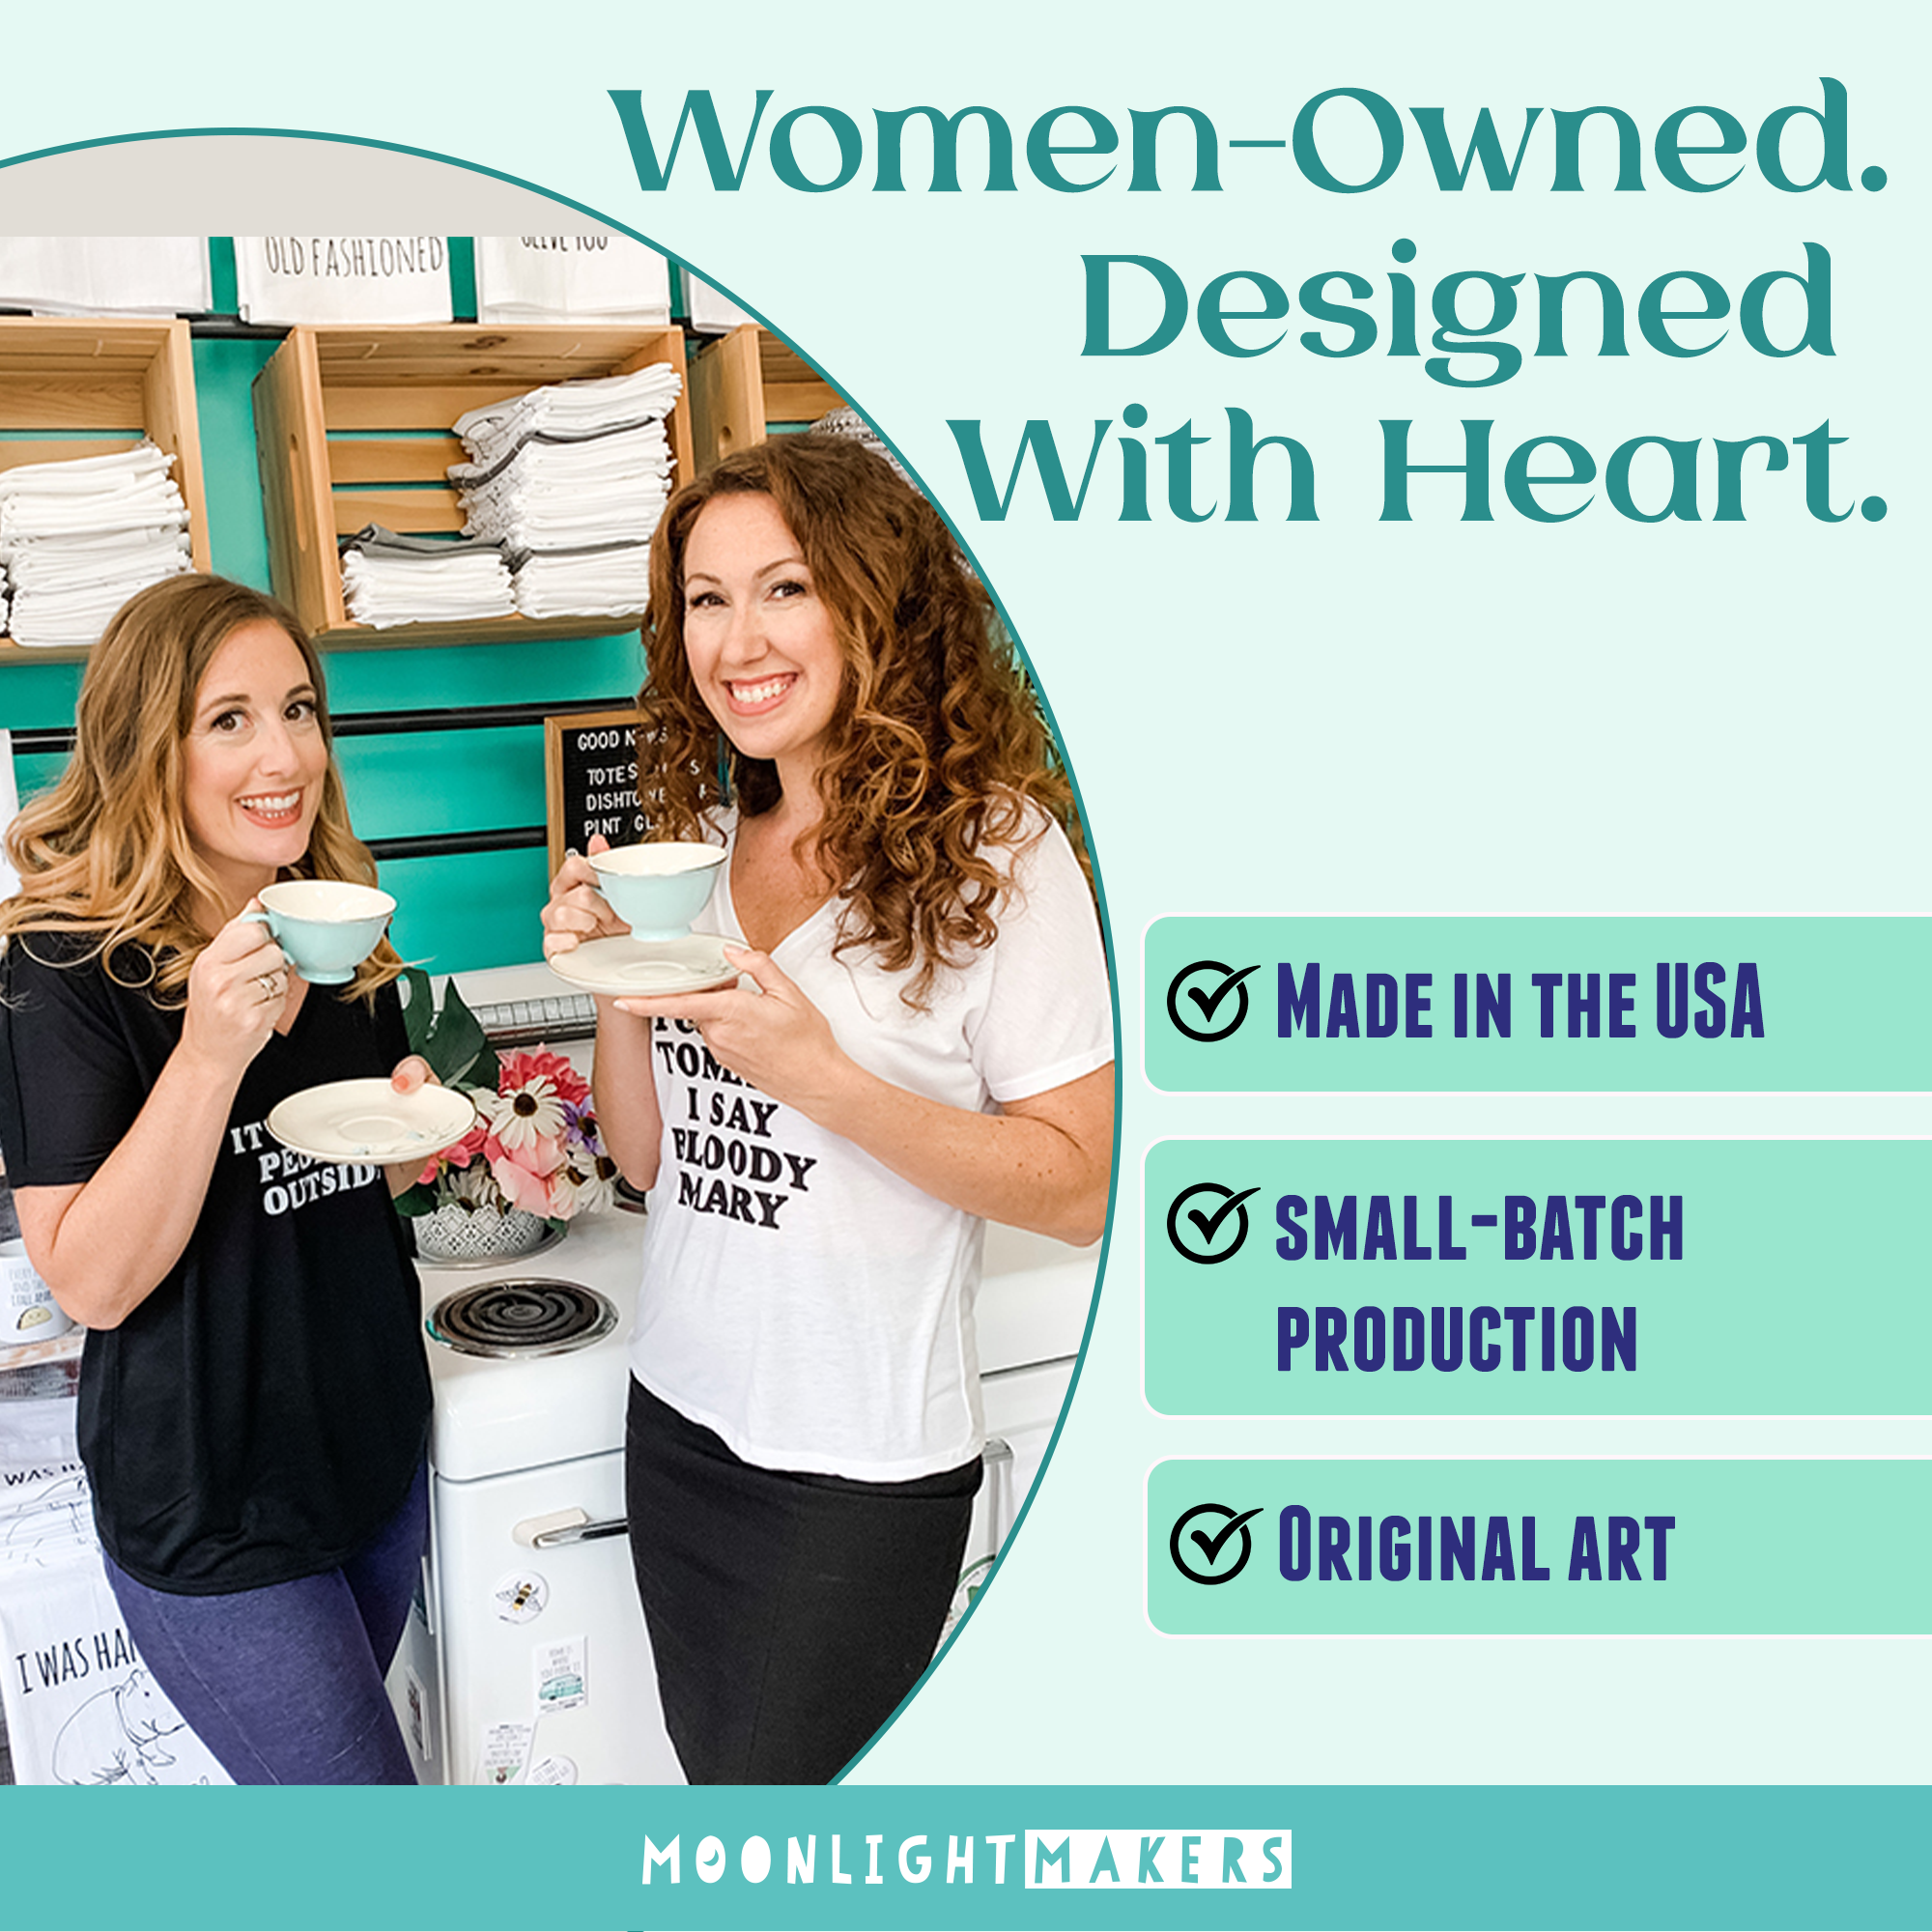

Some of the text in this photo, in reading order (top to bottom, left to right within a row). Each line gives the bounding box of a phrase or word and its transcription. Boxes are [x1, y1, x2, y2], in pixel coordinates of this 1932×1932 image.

[265, 236, 443, 277] OLD FASHIONED
[578, 726, 668, 752] GOOD NWS
[586, 762, 639, 786] TOTES
[584, 816, 621, 837] PINT
[686, 1087, 779, 1138] I SAY
[671, 1127, 817, 1191] BLOODY
[263, 1164, 382, 1216] OUTSID
[677, 1171, 788, 1230] MARY
[15, 1654, 32, 1694] I
[36, 1636, 90, 1689] WAS
